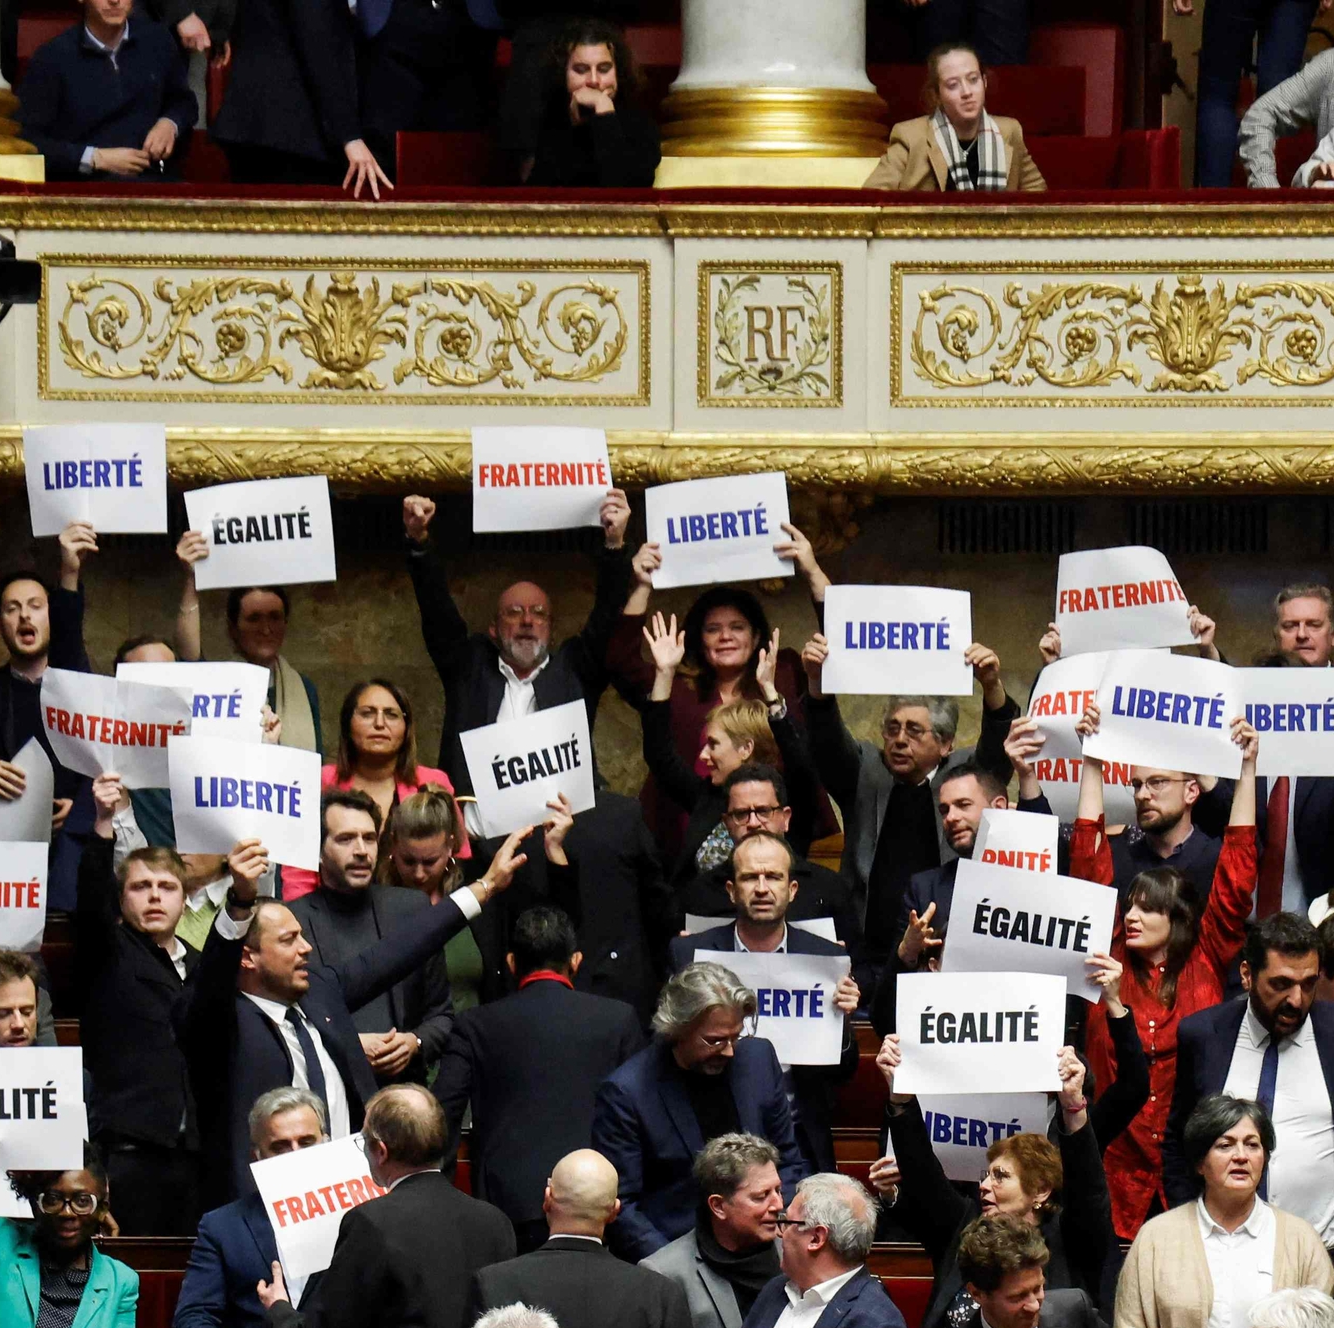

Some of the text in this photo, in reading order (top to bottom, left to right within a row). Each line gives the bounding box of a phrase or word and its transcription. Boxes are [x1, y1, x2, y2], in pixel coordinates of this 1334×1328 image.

[744, 305, 805, 362] RF
[43, 452, 143, 490] LIBERTÉ
[479, 458, 608, 488] FRATERNITÉ
[212, 505, 313, 546] ÉGALITÉ
[667, 502, 769, 545] LIBERTÉ
[1059, 577, 1187, 614] FRATERNITÉ
[845, 616, 951, 651] LIBERTÉ
[1111, 685, 1225, 729] LIBERTÉ
[492, 733, 581, 790] ÉGALITÉ
[194, 776, 301, 818] LIBERTÉ
[972, 898, 1091, 953] ÉGALITÉ
[757, 984, 824, 1018] ERTÉ
[920, 1005, 1039, 1044] ÉGALITÉ
